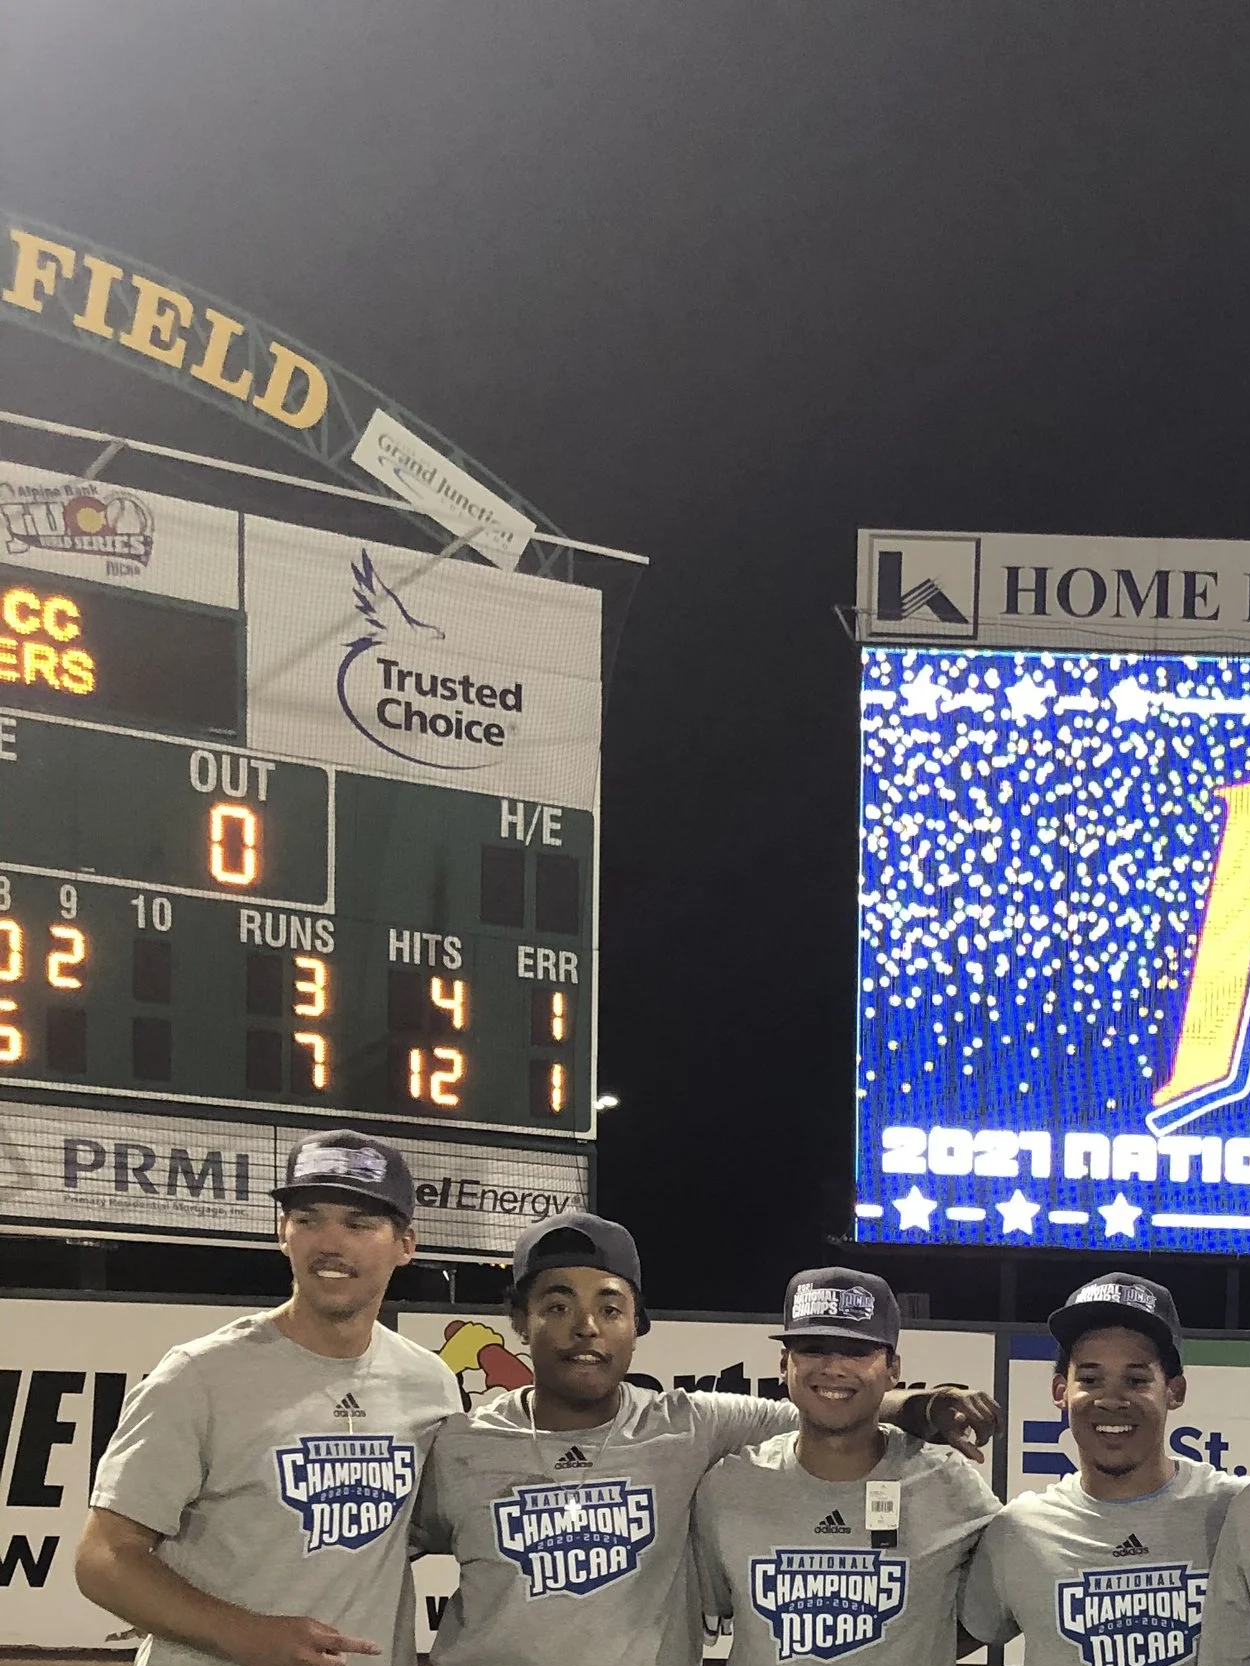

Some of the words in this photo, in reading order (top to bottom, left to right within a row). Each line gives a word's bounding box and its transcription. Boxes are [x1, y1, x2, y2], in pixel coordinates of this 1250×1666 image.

[3, 229, 329, 431] FIELD
[378, 433, 438, 484] Grand
[3, 588, 81, 643] CC
[1001, 565, 1220, 623] HOME
[377, 658, 523, 713] Trusted
[377, 697, 505, 746] Choice
[190, 749, 275, 801] OUT
[211, 803, 257, 885] 0
[500, 804, 563, 847] H/E
[59, 884, 78, 920] 9
[130, 894, 173, 932] 10
[239, 908, 335, 953] RUNS
[388, 928, 464, 969] HITS
[517, 945, 579, 985] ERR
[46, 924, 86, 990] 2
[294, 956, 328, 1018] 3
[430, 975, 466, 1031] 4
[551, 990, 565, 1042] 1
[294, 1031, 328, 1090] 7
[409, 1047, 467, 1107] 12
[550, 1062, 564, 1113] 1
[63, 1138, 250, 1202] PRMI
[882, 1126, 1052, 1180] 2021
[457, 1179, 570, 1223] Energy
[792, 1301, 838, 1319] CHAMPS
[333, 1409, 367, 1418] addas
[314, 1441, 386, 1457] NATIONAL
[554, 1461, 594, 1470] adidas
[1169, 1426, 1249, 1477] St.
[281, 1450, 412, 1503] CHAMPIONS
[320, 1487, 386, 1502] 2020-2021
[531, 1488, 616, 1508] NATIONAL
[309, 1501, 393, 1550] NJCAA
[499, 1494, 651, 1552] CHAMPIONS
[537, 1533, 619, 1550] 2020-2021
[814, 1525, 852, 1534] adidas
[528, 1546, 628, 1594] NJCAA
[786, 1556, 869, 1570] NATIONAL
[1112, 1547, 1150, 1558] adidas
[755, 1563, 901, 1612] CHAMPIONS
[788, 1598, 865, 1613] 2020-2021
[1094, 1572, 1175, 1591] NATIONAL
[1062, 1578, 1210, 1635] CHAMPIONS
[1098, 1617, 1175, 1634] 2020-2021
[781, 1612, 873, 1658] NJCAA
